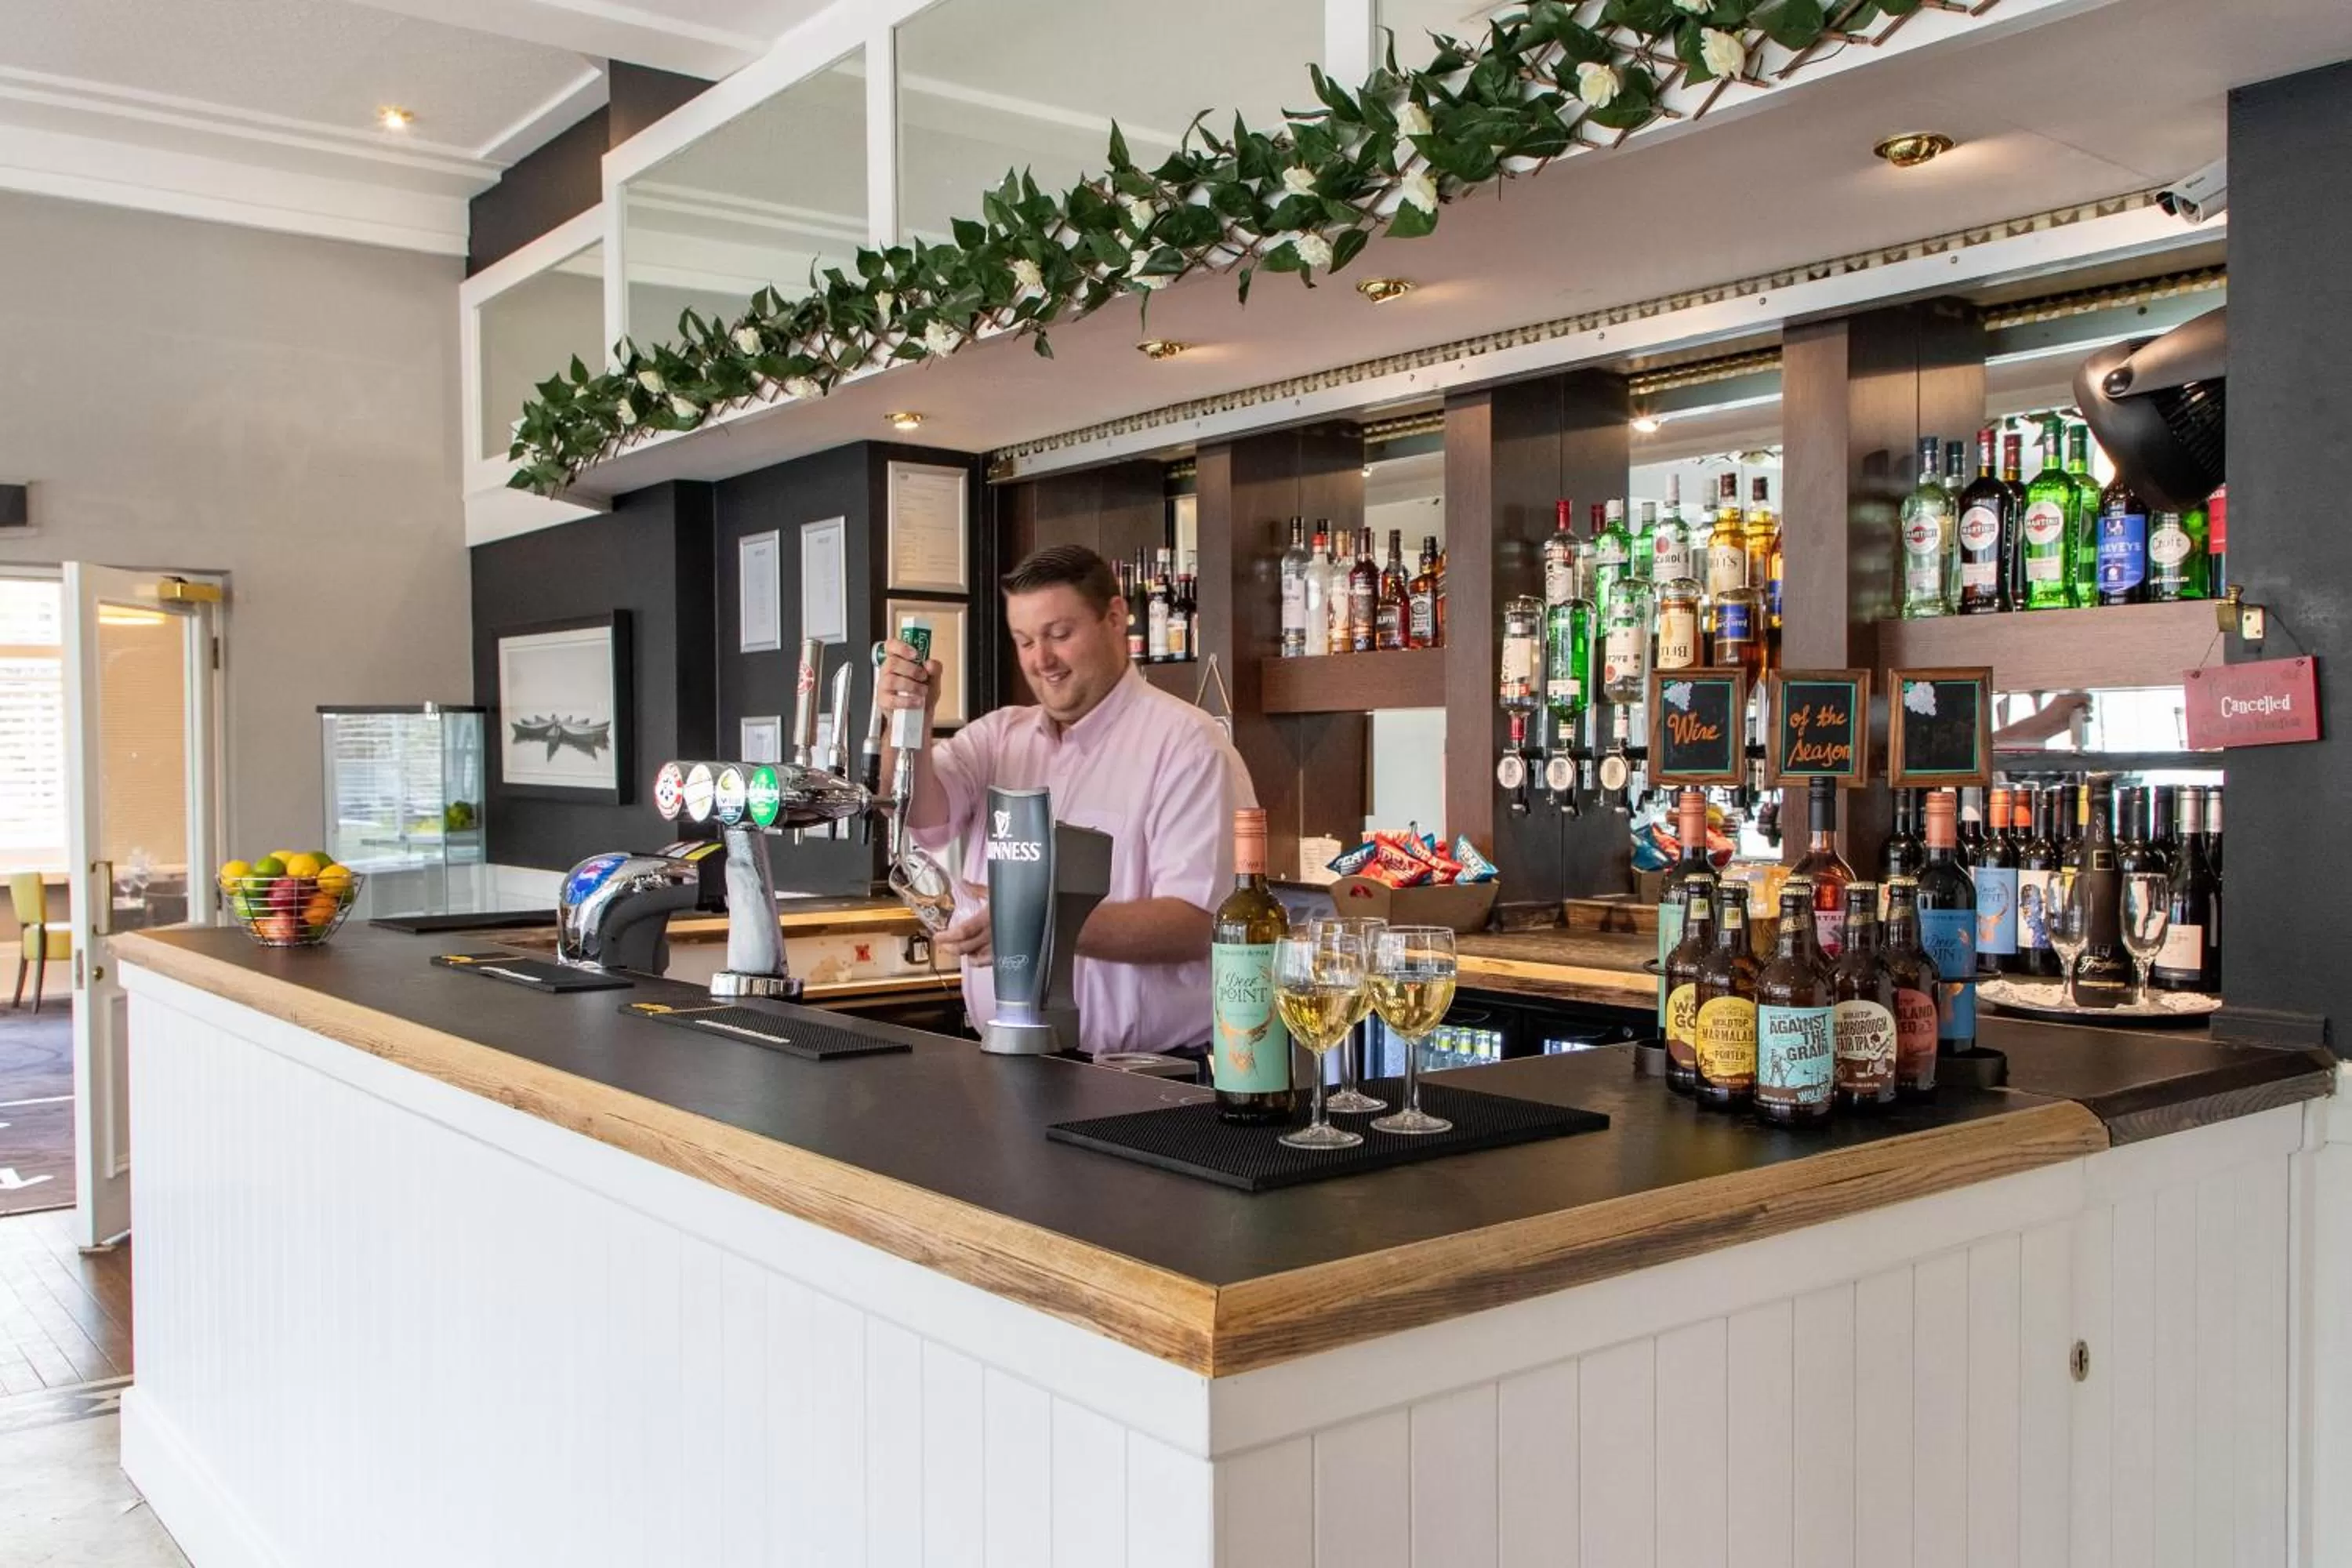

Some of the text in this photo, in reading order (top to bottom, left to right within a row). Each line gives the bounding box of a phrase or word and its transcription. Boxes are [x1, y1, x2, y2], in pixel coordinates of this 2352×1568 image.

[2220, 693, 2292, 718] Cancelled
[1667, 711, 1722, 745] Wine
[1789, 703, 1848, 736] of the
[1788, 739, 1851, 768] season
[1218, 986, 1269, 1004] POINT
[1701, 1028, 1754, 1043] MARMALAD
[1769, 1012, 1828, 1036] AGAINST
[1802, 1028, 1827, 1047] THE
[1714, 1049, 1748, 1061] PORTER
[1786, 1038, 1830, 1061] GRAIN
